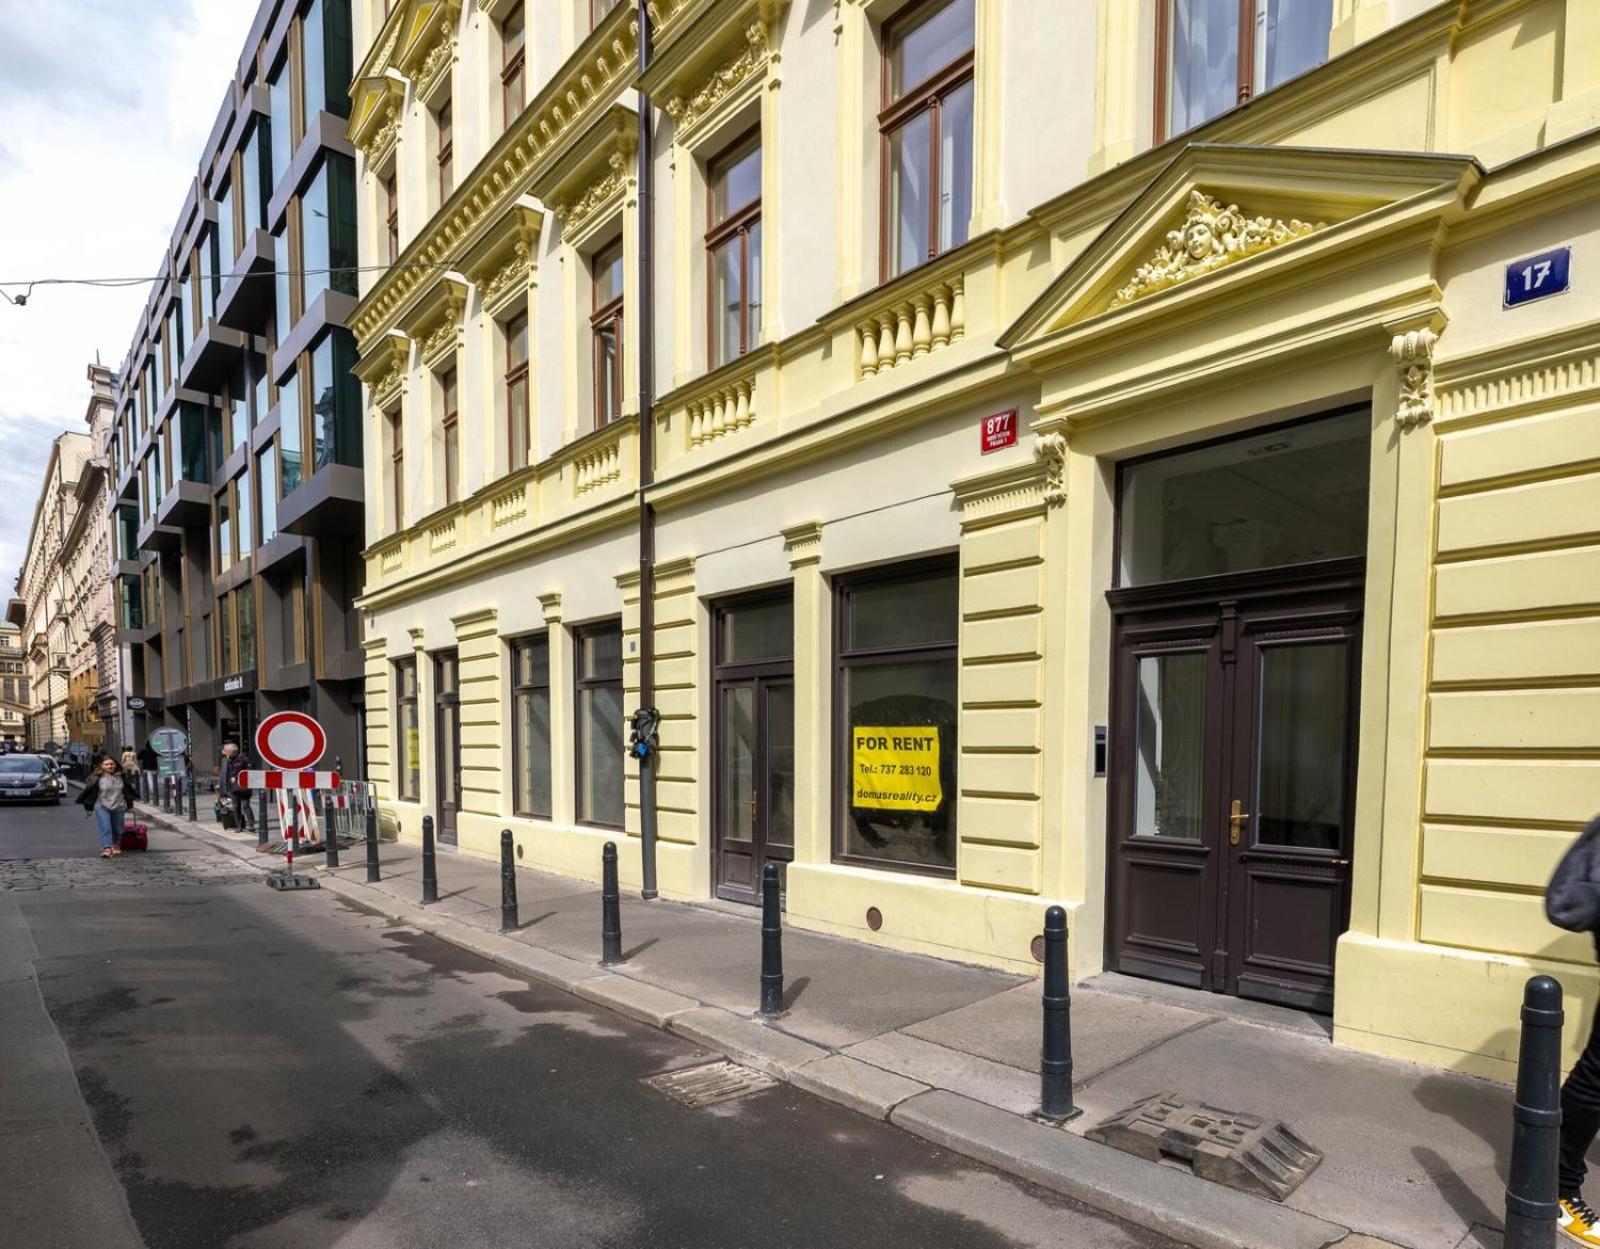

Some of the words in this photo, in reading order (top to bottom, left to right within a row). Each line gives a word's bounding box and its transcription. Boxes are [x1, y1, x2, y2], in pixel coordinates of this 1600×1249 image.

[1522, 260, 1551, 291] 17
[987, 413, 1010, 434] 877
[856, 737, 888, 750] FOR
[893, 737, 934, 751] RENT
[860, 763, 878, 774] Tel.:
[880, 764, 897, 775] 737
[916, 765, 932, 777] 120
[857, 789, 937, 803] domusreality.cz
